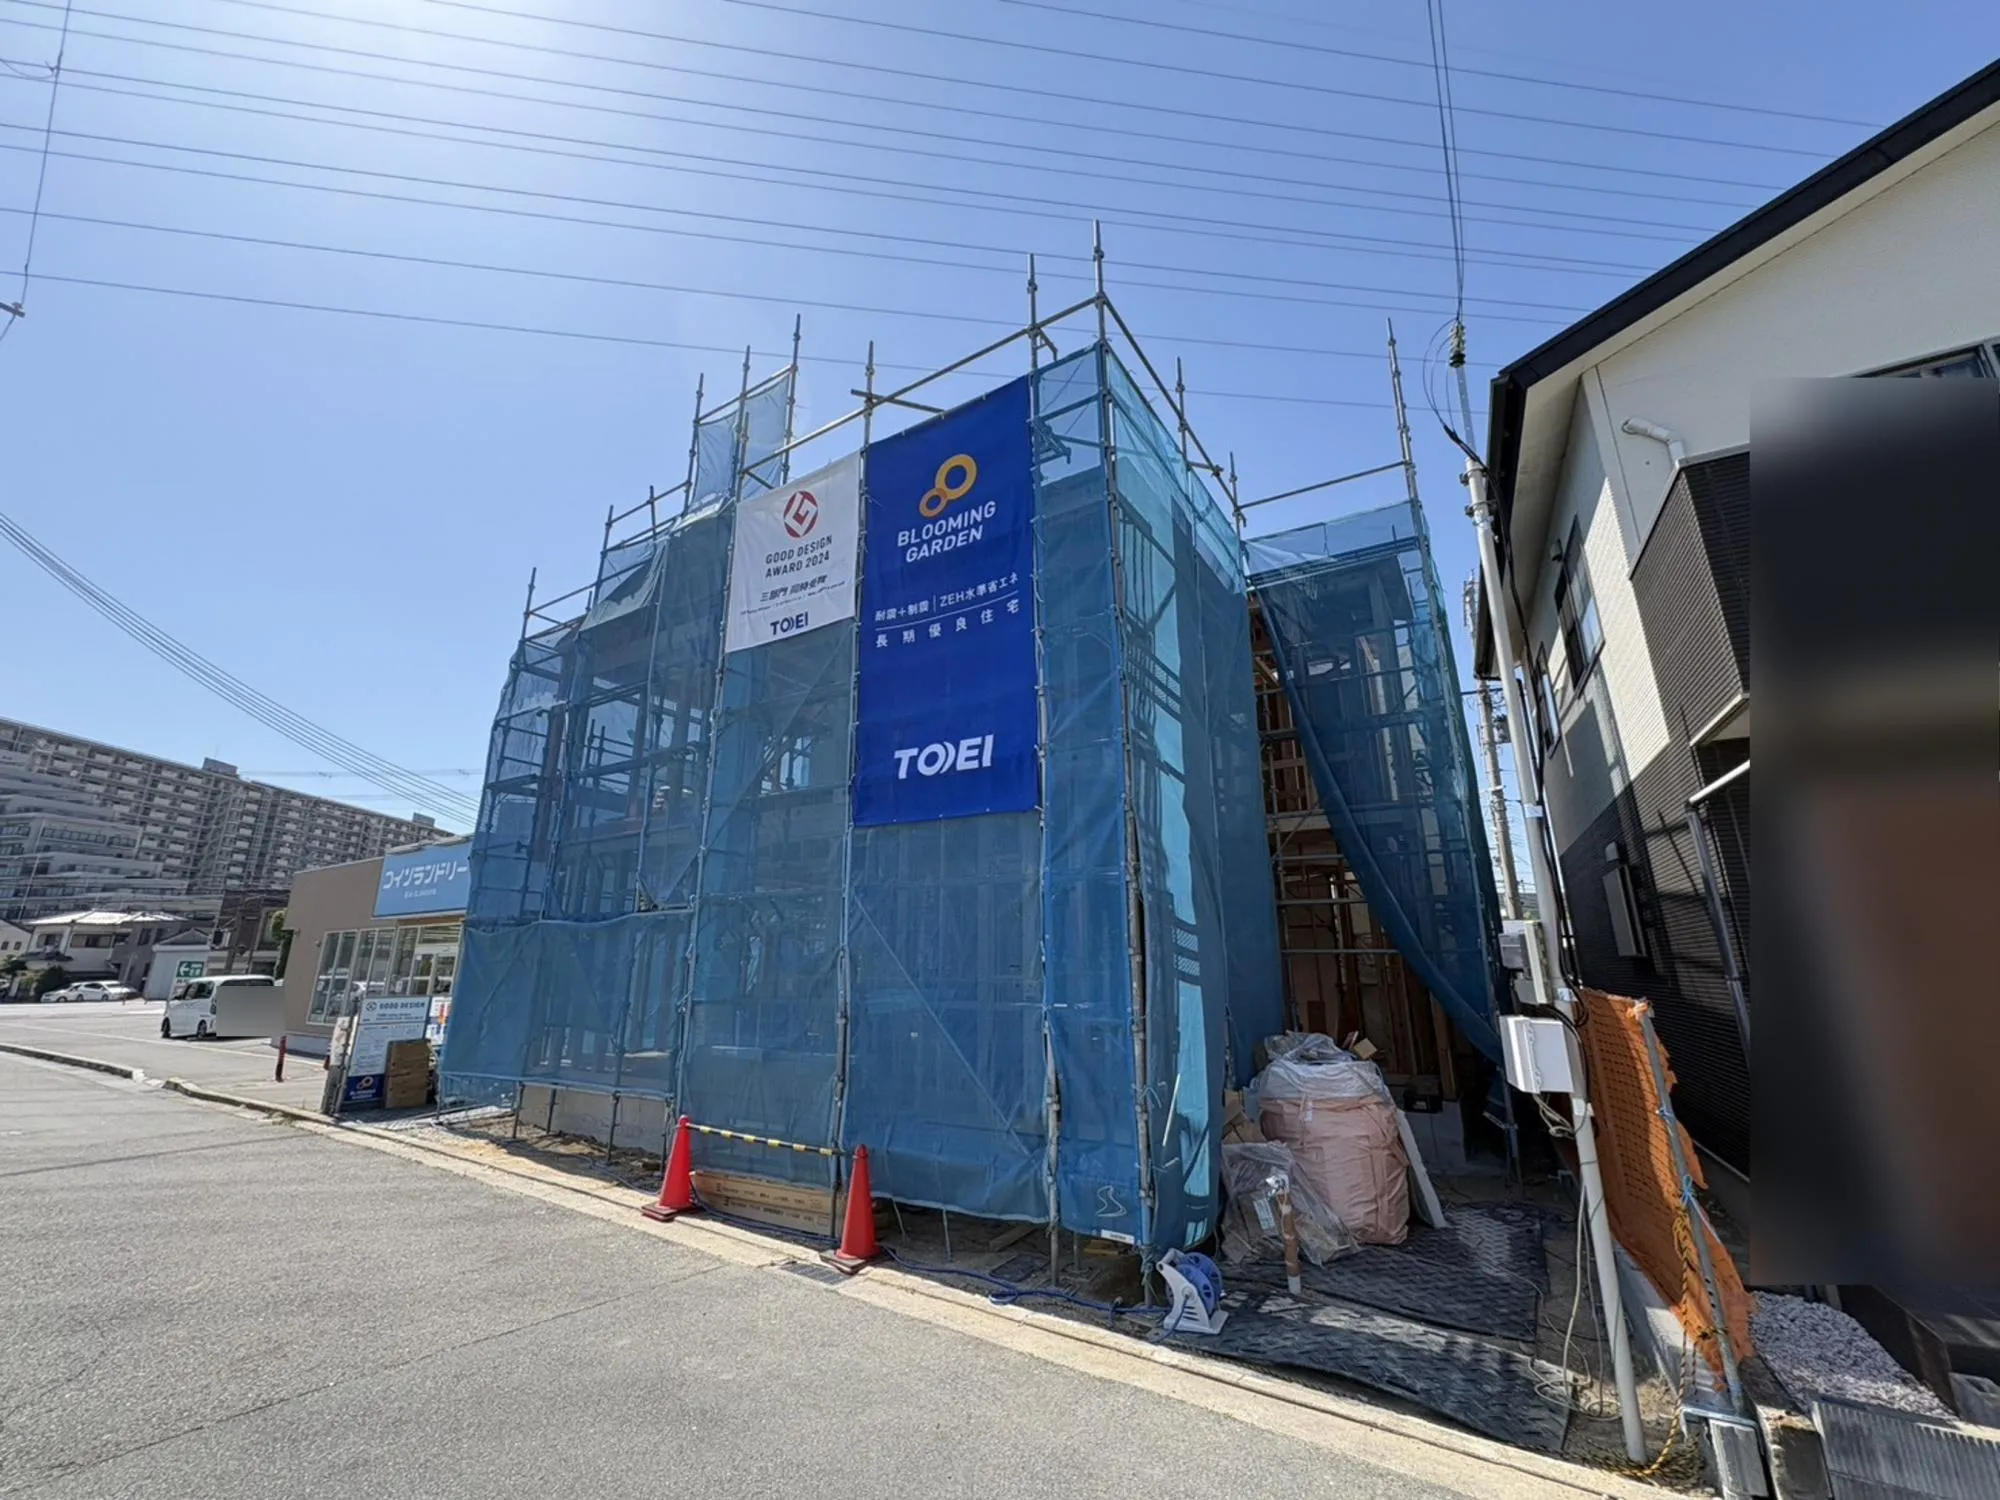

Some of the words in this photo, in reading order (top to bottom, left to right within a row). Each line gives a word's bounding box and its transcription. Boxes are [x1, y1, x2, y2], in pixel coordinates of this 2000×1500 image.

[897, 500, 997, 547] BLOOMING
[765, 550, 794, 565] GOOD
[797, 535, 833, 557] DESIGN
[905, 525, 984, 563] GARDEN
[765, 559, 803, 579] AWARD
[805, 550, 831, 569] 2024
[876, 599, 1020, 648] 長期優良住宅
[383, 861, 468, 889] コインランドリー
